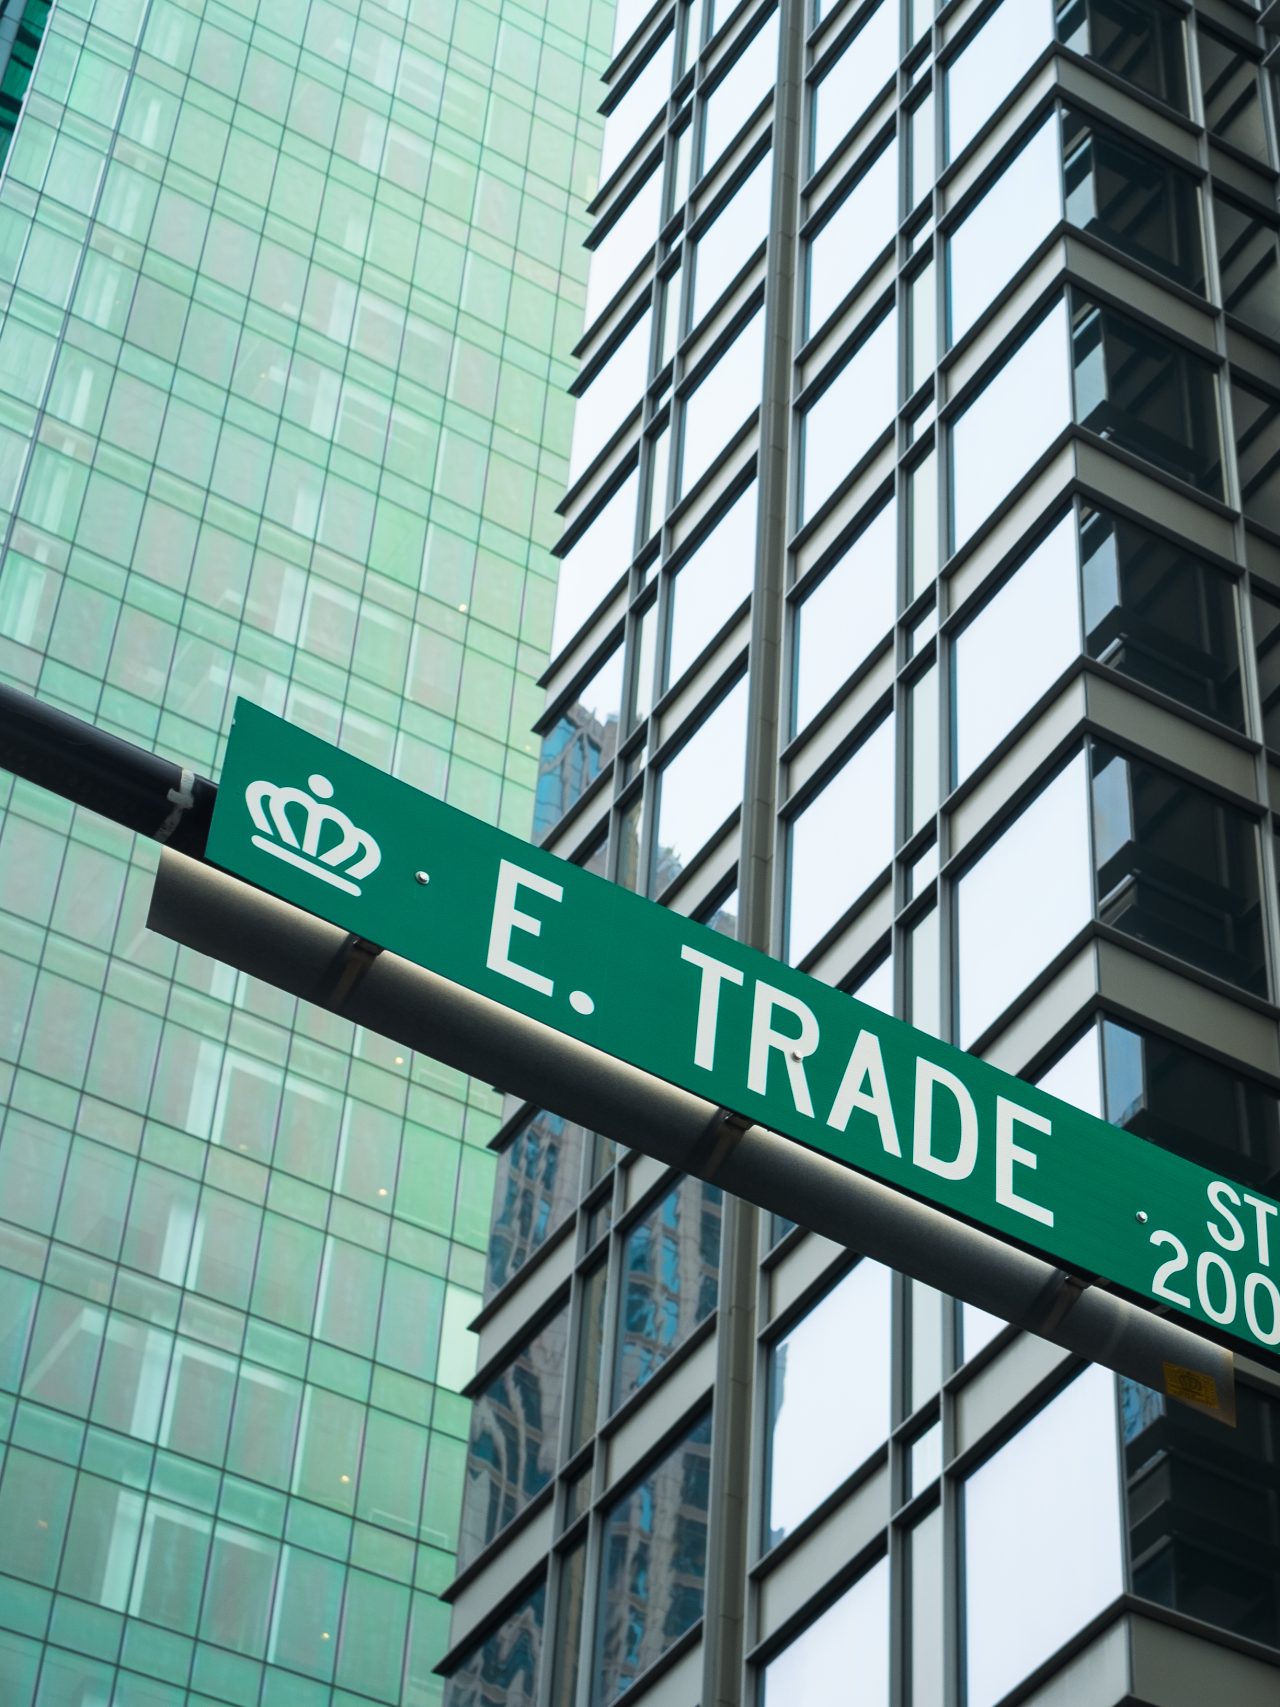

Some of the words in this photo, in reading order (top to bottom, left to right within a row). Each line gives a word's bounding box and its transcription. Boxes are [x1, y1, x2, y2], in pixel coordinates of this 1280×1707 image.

[486, 858, 595, 1015] E.
[680, 944, 1055, 1228] TRADE
[1206, 1180, 1278, 1267] ST
